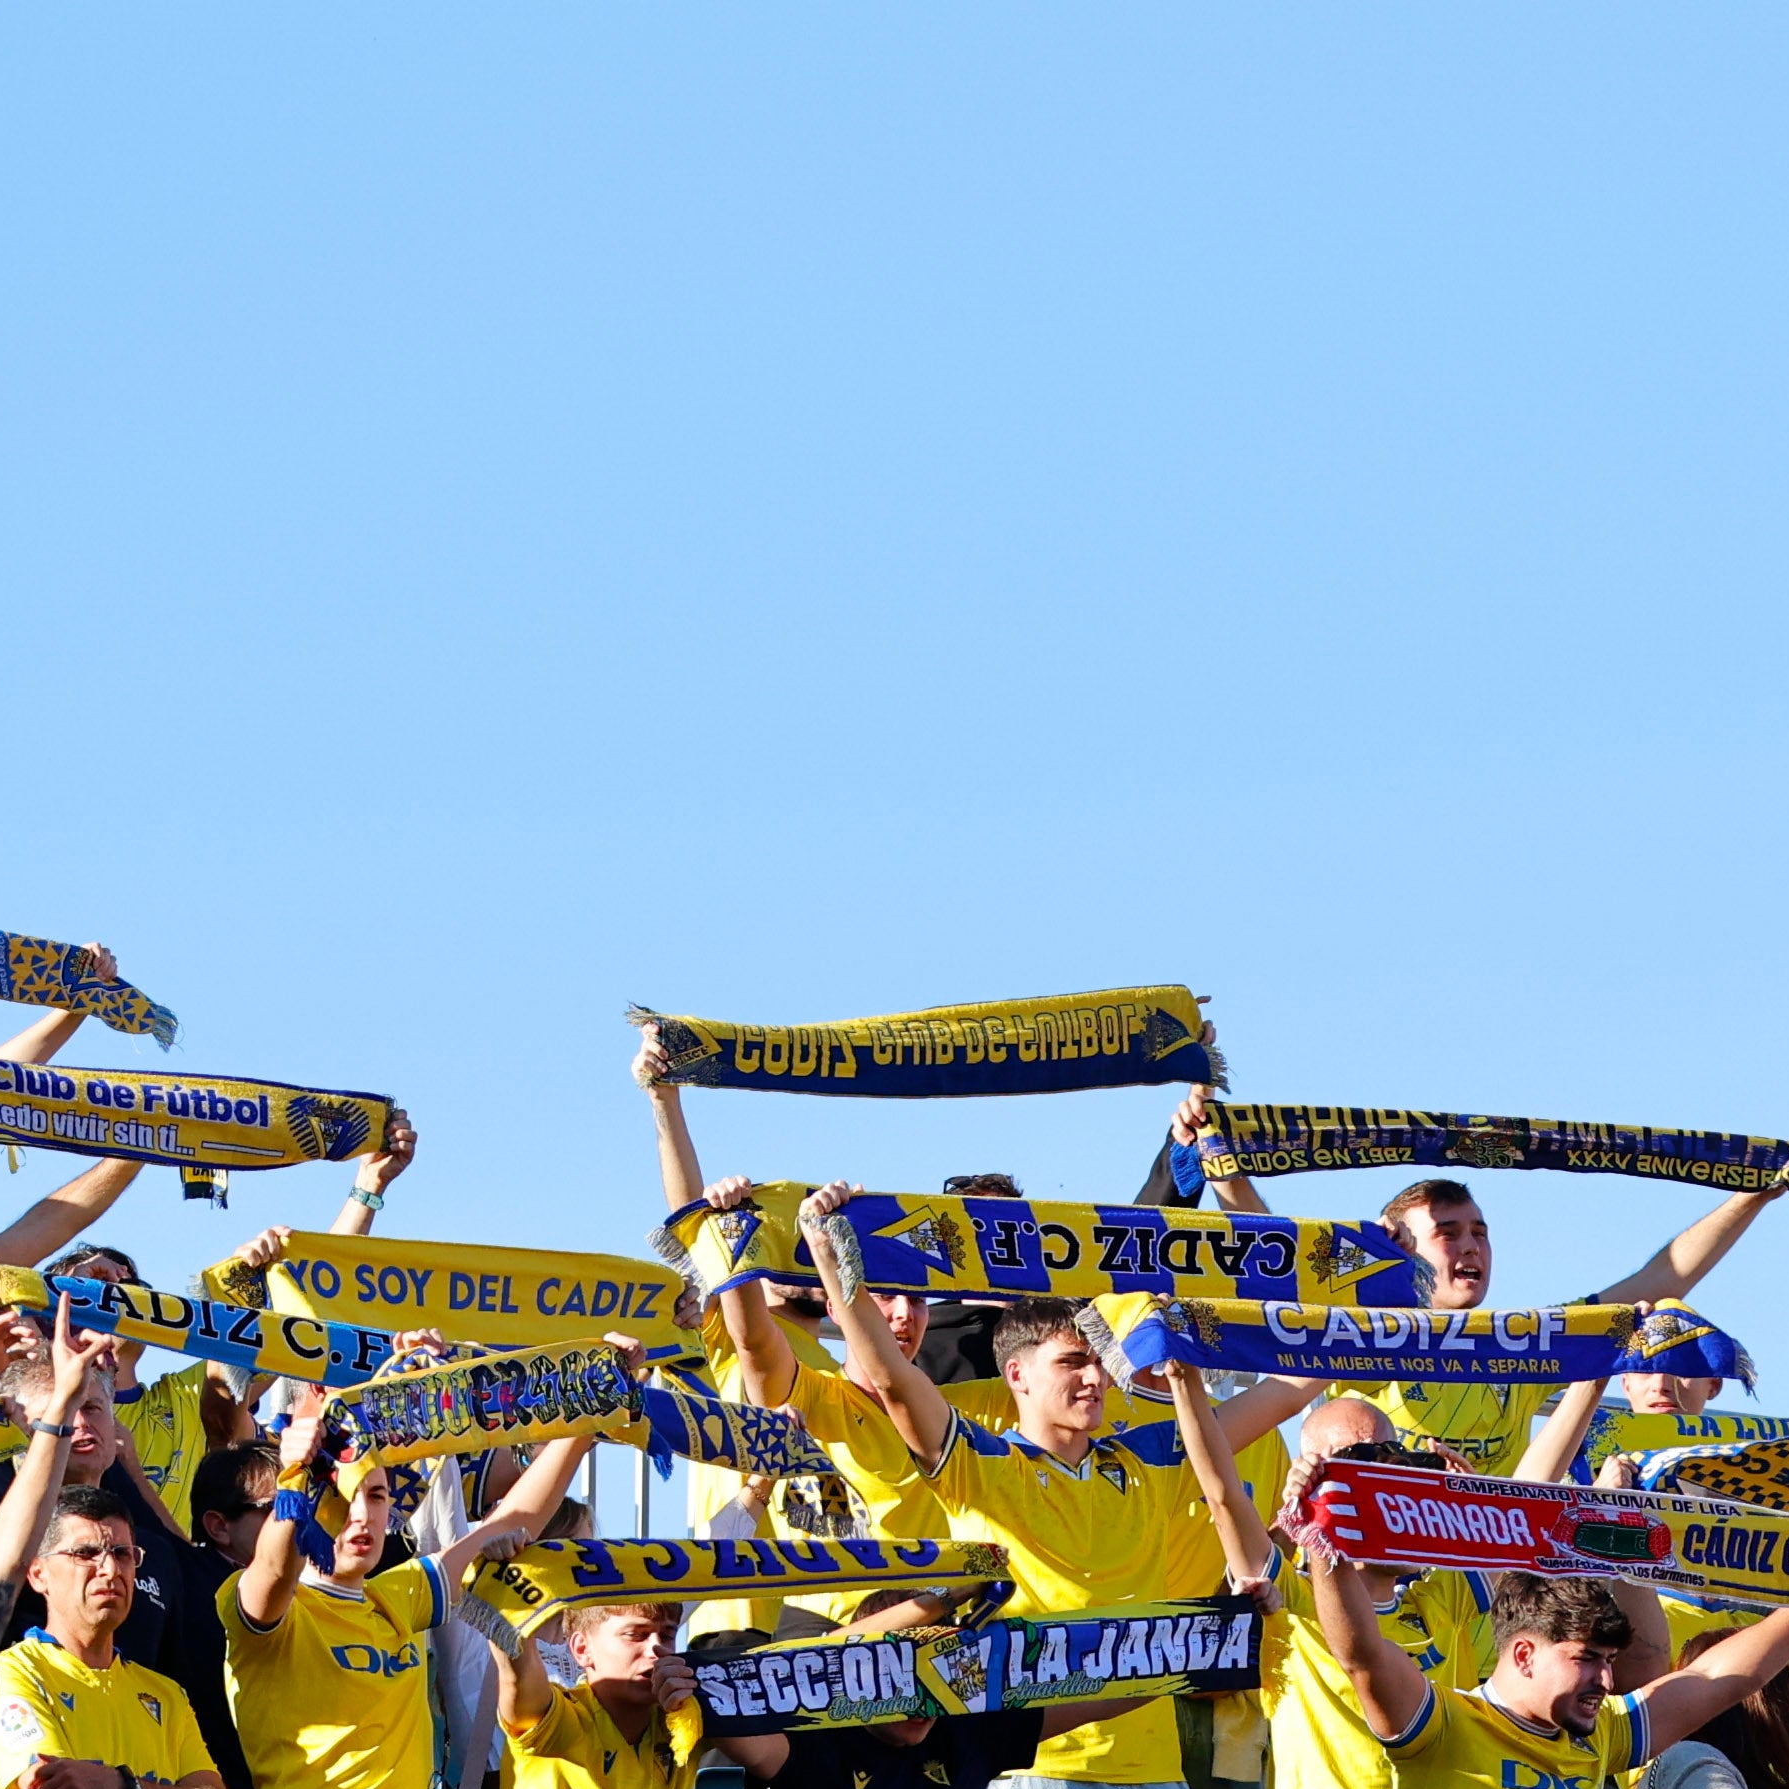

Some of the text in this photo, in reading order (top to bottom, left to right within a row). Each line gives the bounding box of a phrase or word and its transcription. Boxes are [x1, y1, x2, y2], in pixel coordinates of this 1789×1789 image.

[85, 1077, 136, 1111] de
[142, 1081, 270, 1128] Fútbol
[50, 1106, 110, 1142] vivir
[114, 1115, 154, 1149] sin
[1358, 1146, 1415, 1165] 1982
[1566, 1150, 1632, 1170] XXXV
[1092, 1223, 1298, 1278] CADIZ
[285, 1258, 665, 1320] YO SOY DEL CADIZ
[1263, 1300, 1567, 1352] CADIZ CF
[1277, 1353, 1560, 1375] NI LA MUERTE NOS VA A SEPARAR
[1676, 1414, 1723, 1438] LA
[1374, 1491, 1537, 1548] GRANADA
[1446, 1476, 1743, 1517] CAMPEONATO NACIONAL DE LIGA
[1682, 1518, 1779, 1577] CÁDIZ
[491, 1560, 545, 1606] 1910
[695, 1634, 914, 1717] SECCIÓN
[1009, 1625, 1070, 1686] LA
[1075, 1613, 1256, 1683] JANDA
